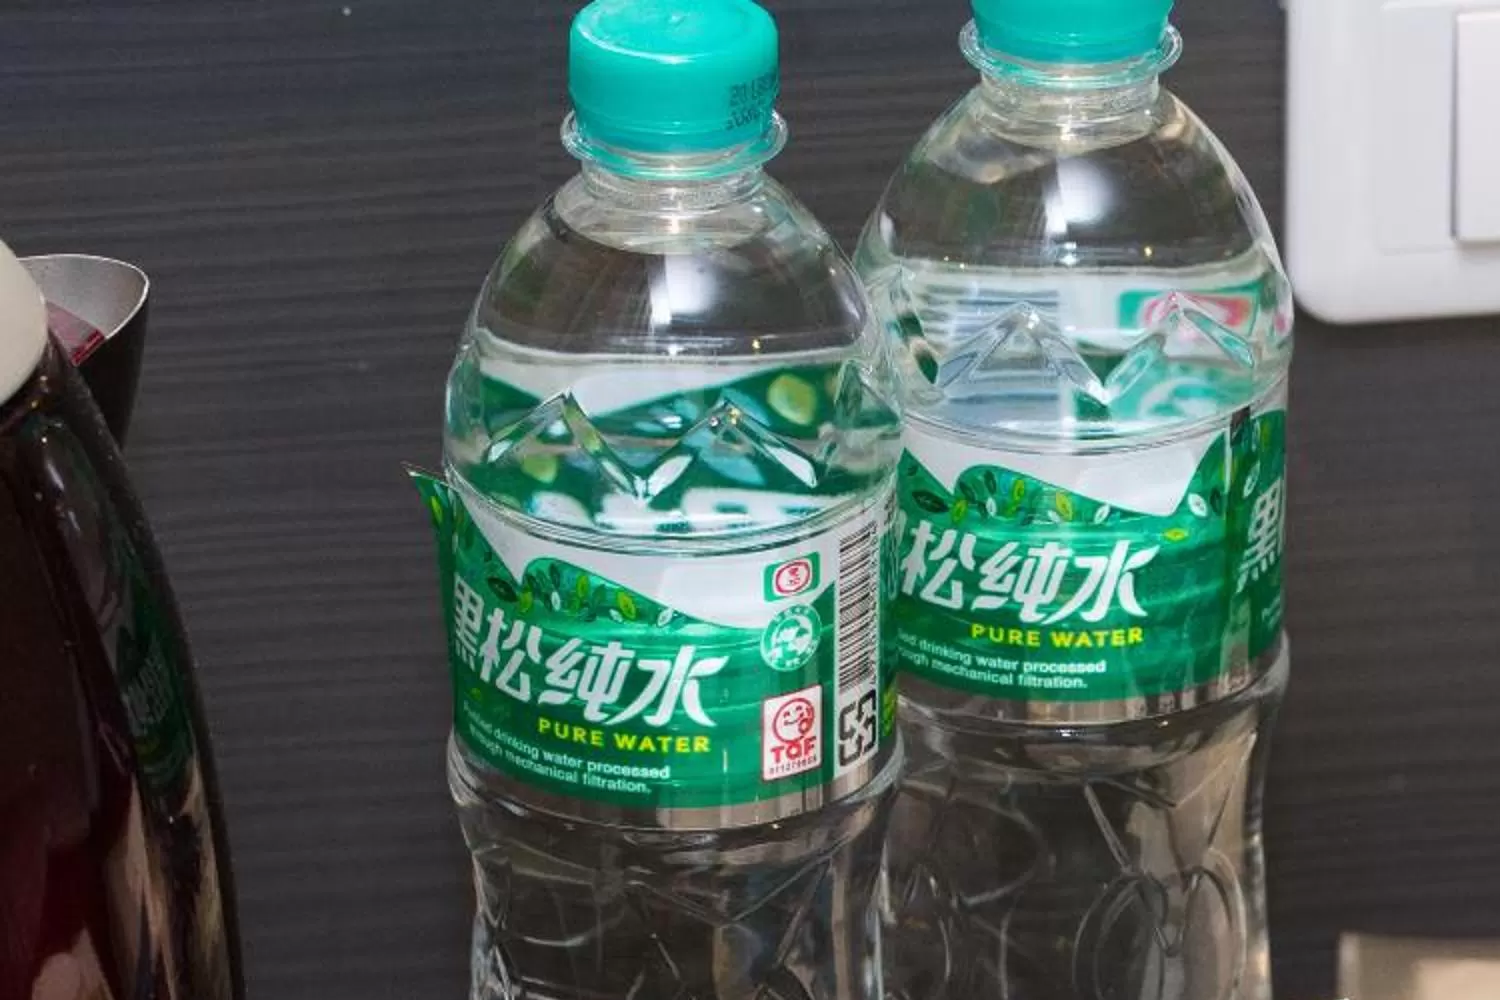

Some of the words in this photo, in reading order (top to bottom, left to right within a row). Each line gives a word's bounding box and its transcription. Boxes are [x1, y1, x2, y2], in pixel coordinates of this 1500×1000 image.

[970, 622, 1040, 648] PURE
[1050, 626, 1144, 648] WATER
[919, 639, 972, 666] drinking
[975, 653, 1018, 672] water
[1022, 659, 1107, 677] processed
[931, 659, 1013, 685] mechanical
[1018, 671, 1088, 689] filtration.
[494, 727, 540, 758] drinking
[542, 748, 582, 769] water
[586, 759, 671, 779] processed
[537, 716, 605, 747] PURE
[614, 732, 713, 753] WATER
[504, 748, 579, 784] mechanical
[582, 772, 653, 794] filtration.
